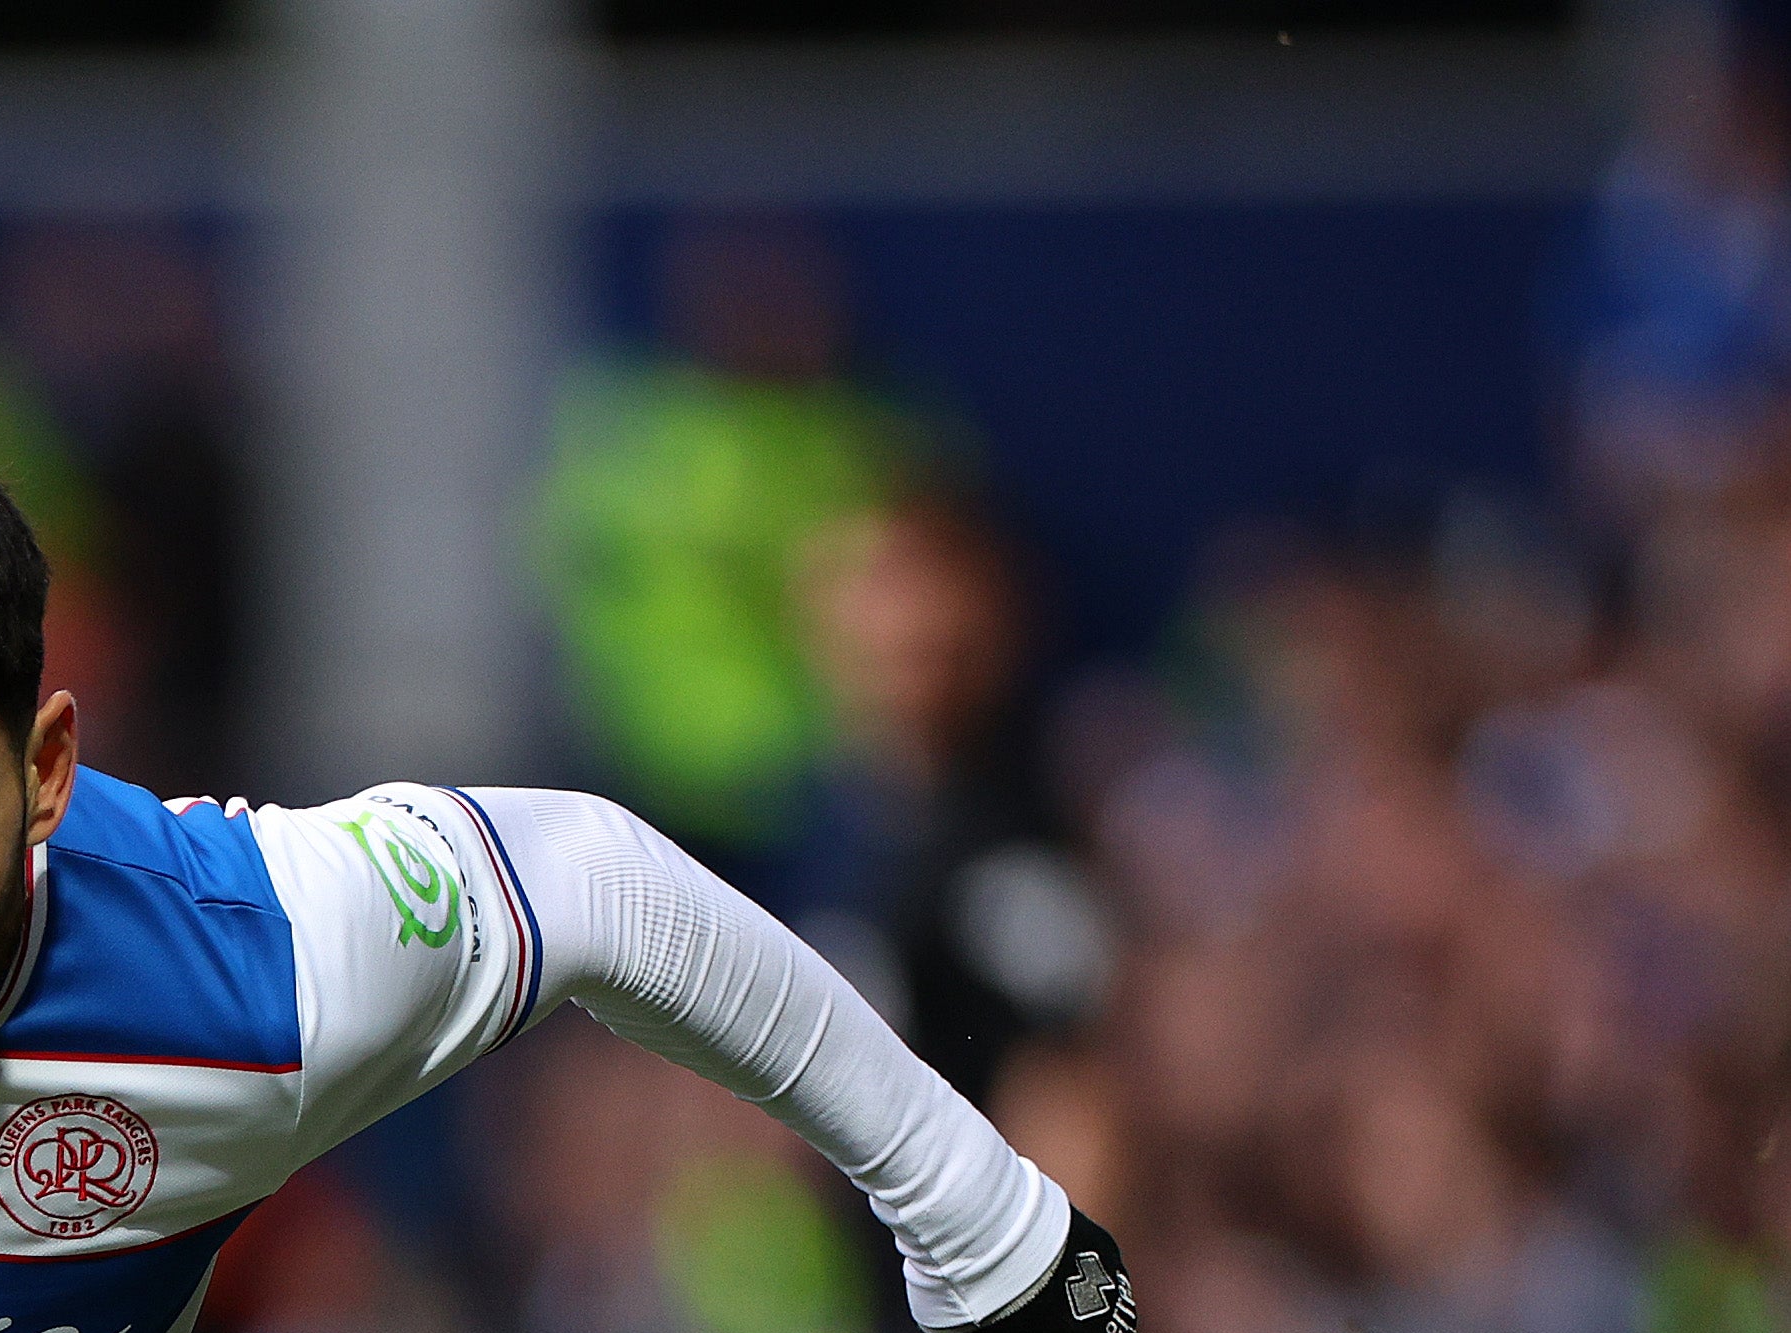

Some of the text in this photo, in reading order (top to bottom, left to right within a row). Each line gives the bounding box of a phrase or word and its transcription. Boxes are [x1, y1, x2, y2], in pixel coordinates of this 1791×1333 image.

[50, 1098, 99, 1113] PARK
[102, 1103, 152, 1166] RANGERS
[49, 1218, 95, 1234] 1882
